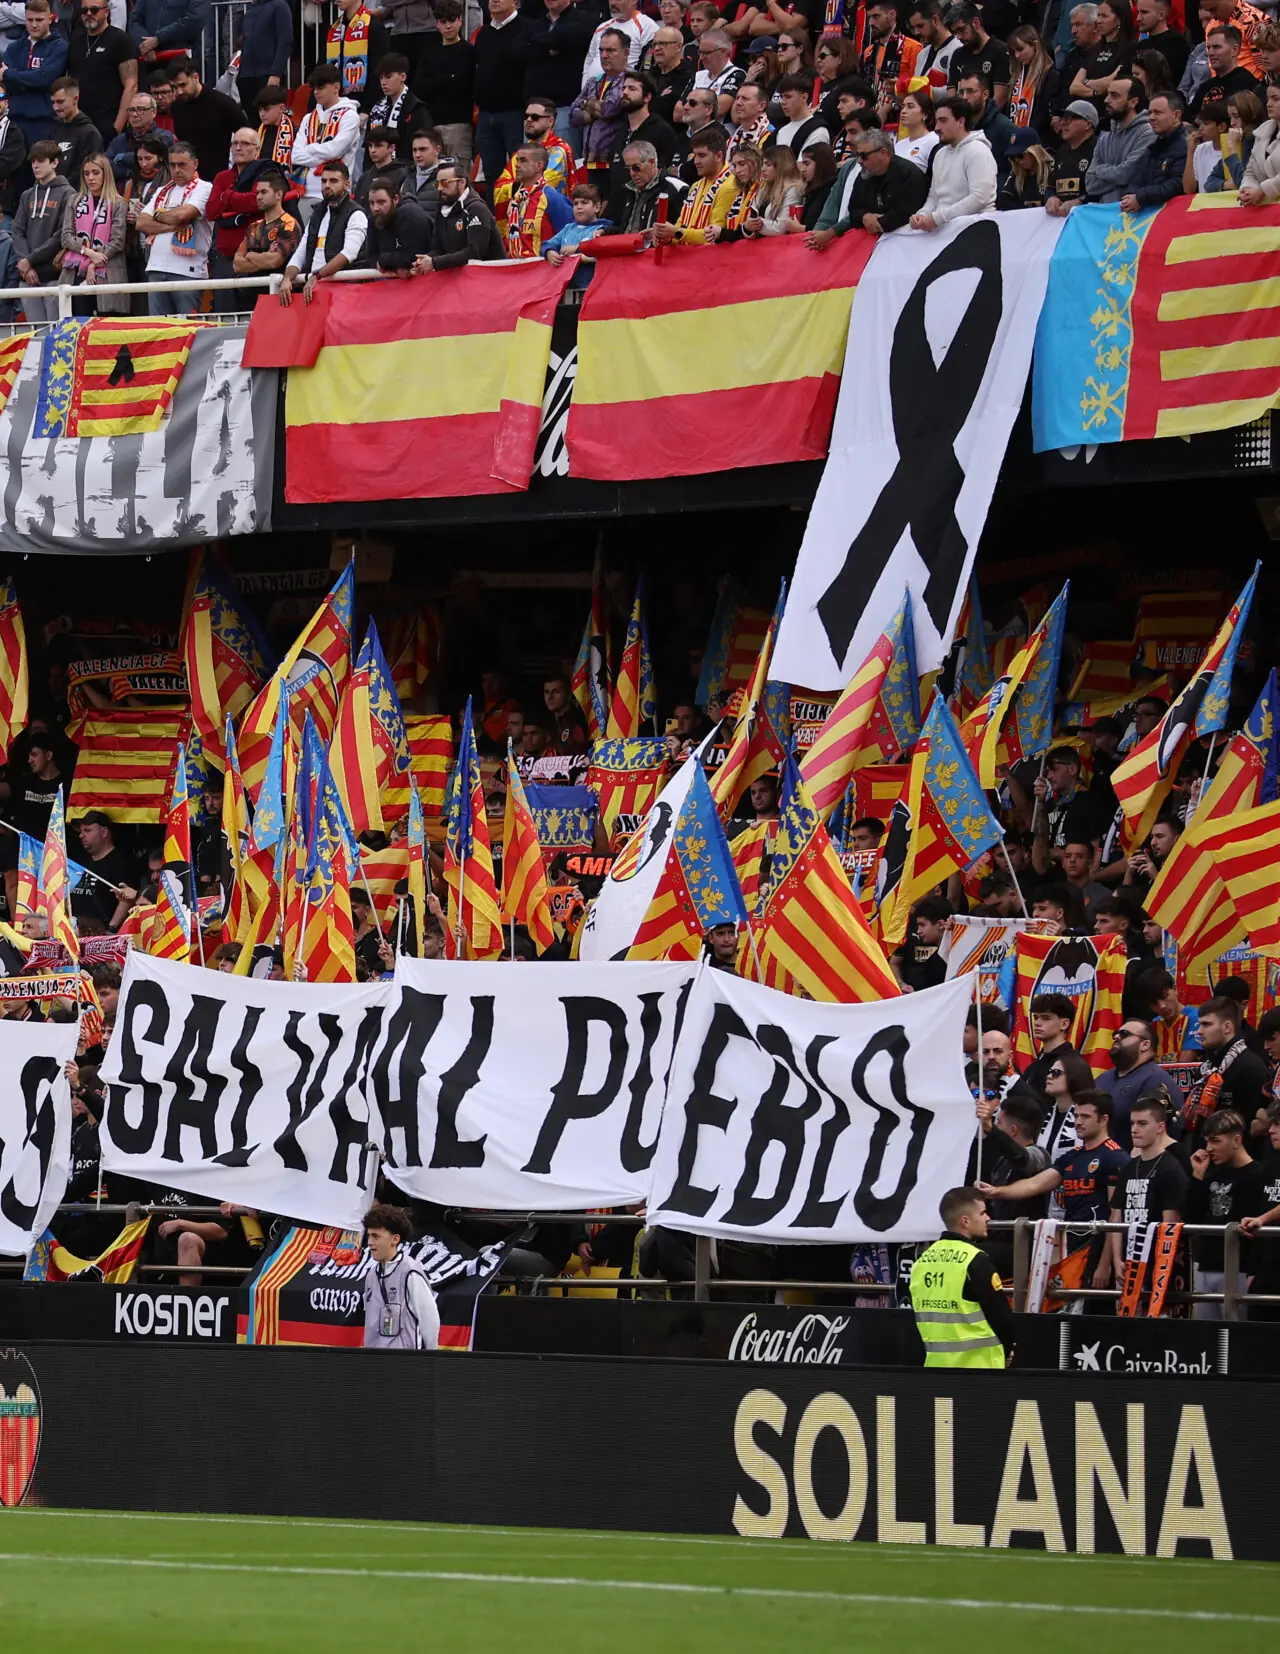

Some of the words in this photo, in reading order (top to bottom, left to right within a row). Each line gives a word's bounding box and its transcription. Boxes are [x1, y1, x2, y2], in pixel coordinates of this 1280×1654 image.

[73, 655, 145, 677] VALENCIA
[150, 653, 169, 669] CF
[367, 985, 497, 1171] AL
[522, 989, 935, 1232] PUEBLO
[923, 1271, 945, 1288] 611
[114, 1292, 229, 1338] kosner
[1105, 1343, 1212, 1374] CaixaBank
[732, 1388, 1235, 1561] SOLLANA
